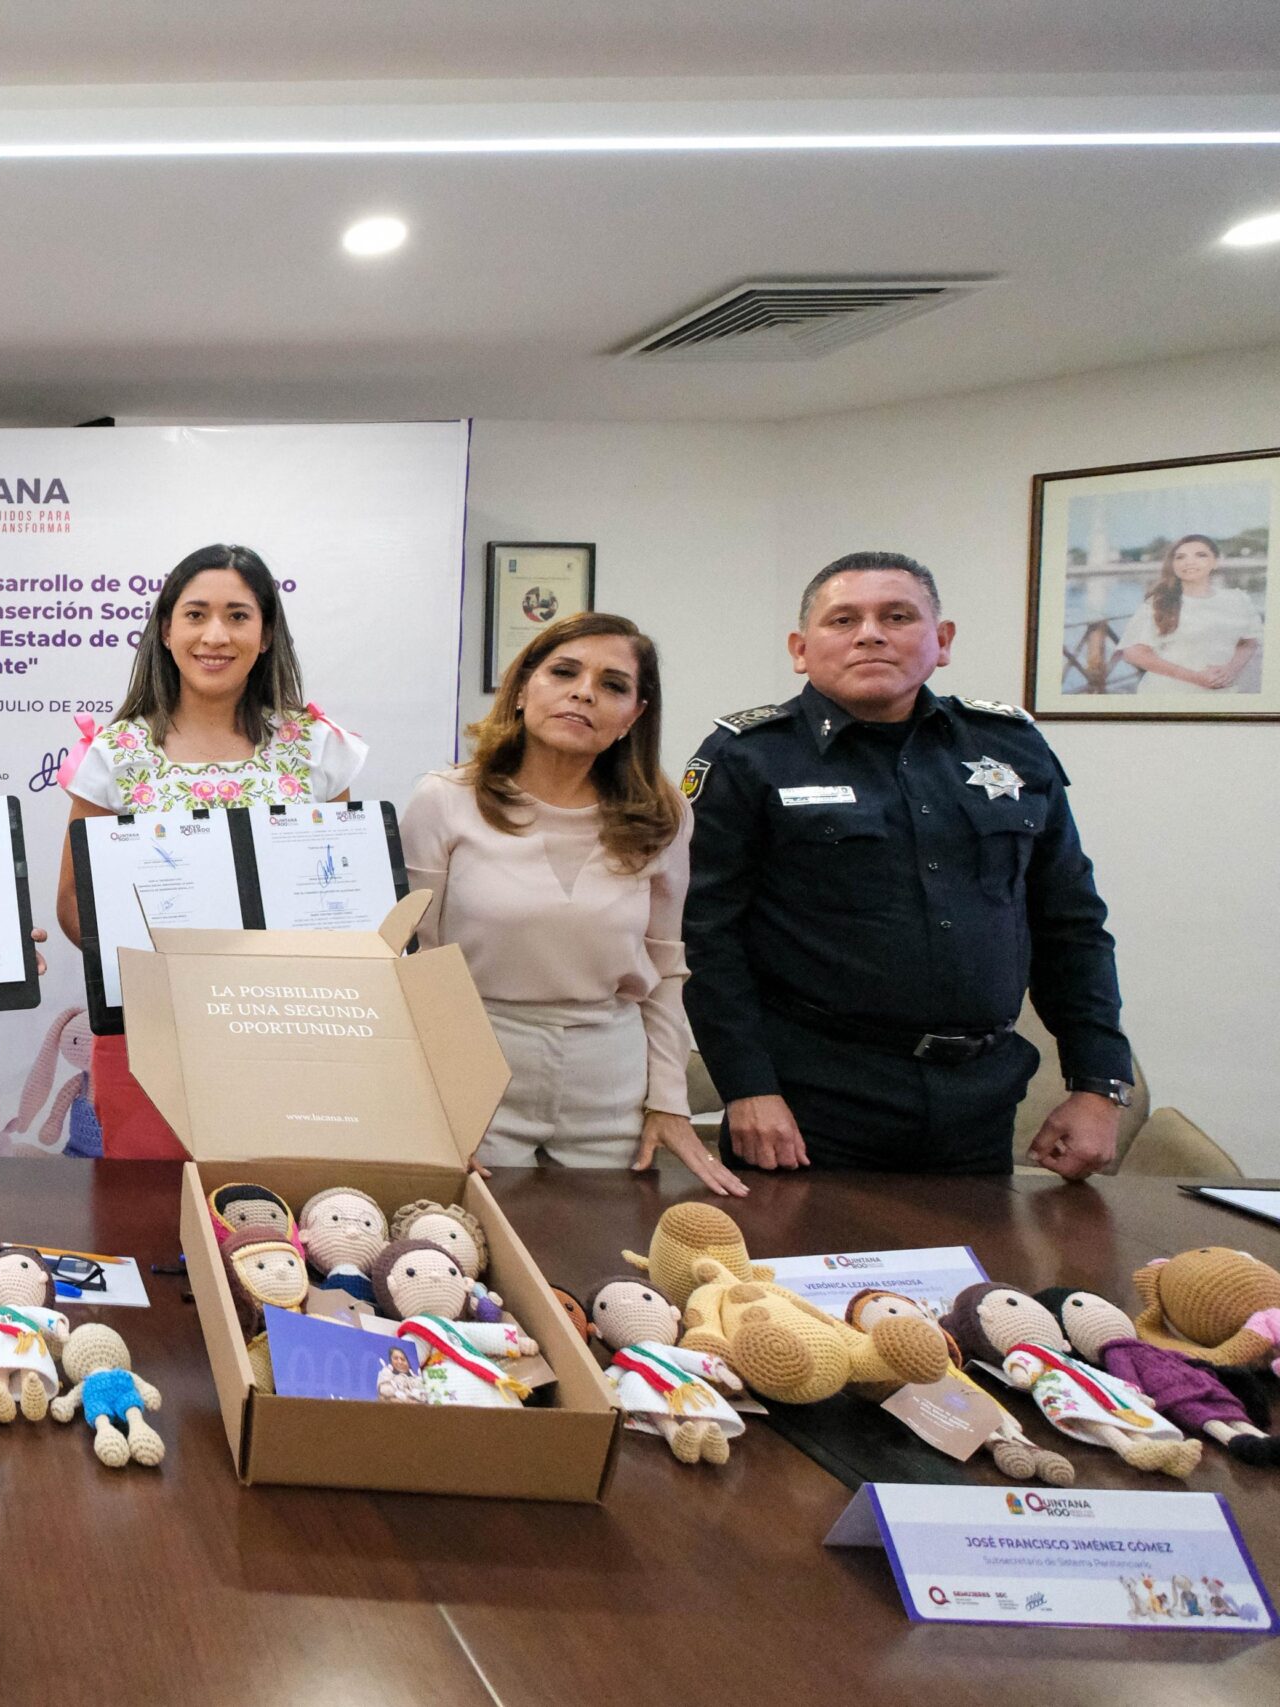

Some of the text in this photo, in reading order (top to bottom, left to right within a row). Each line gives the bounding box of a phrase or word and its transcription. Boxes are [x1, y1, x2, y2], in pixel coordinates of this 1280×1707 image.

[39, 510, 71, 522] PARA
[90, 574, 121, 592] de
[101, 601, 152, 620] Soci
[0, 629, 82, 648] Estado
[89, 629, 119, 648] de
[49, 700, 71, 713] DE
[76, 700, 114, 713] 2025
[211, 985, 360, 1001] LA POSIBILIDAD
[207, 1003, 380, 1020] DE UNA SEGUNDA
[229, 1021, 374, 1038] OPORTUNIDAD
[882, 1278, 924, 1288] ESPINOSA
[1025, 1492, 1091, 1513] QUINTANA
[1046, 1508, 1071, 1518] ROO
[964, 1535, 1174, 1553] JOSÉ FRANCISCO JIMÉNEZ GÓMEZ
